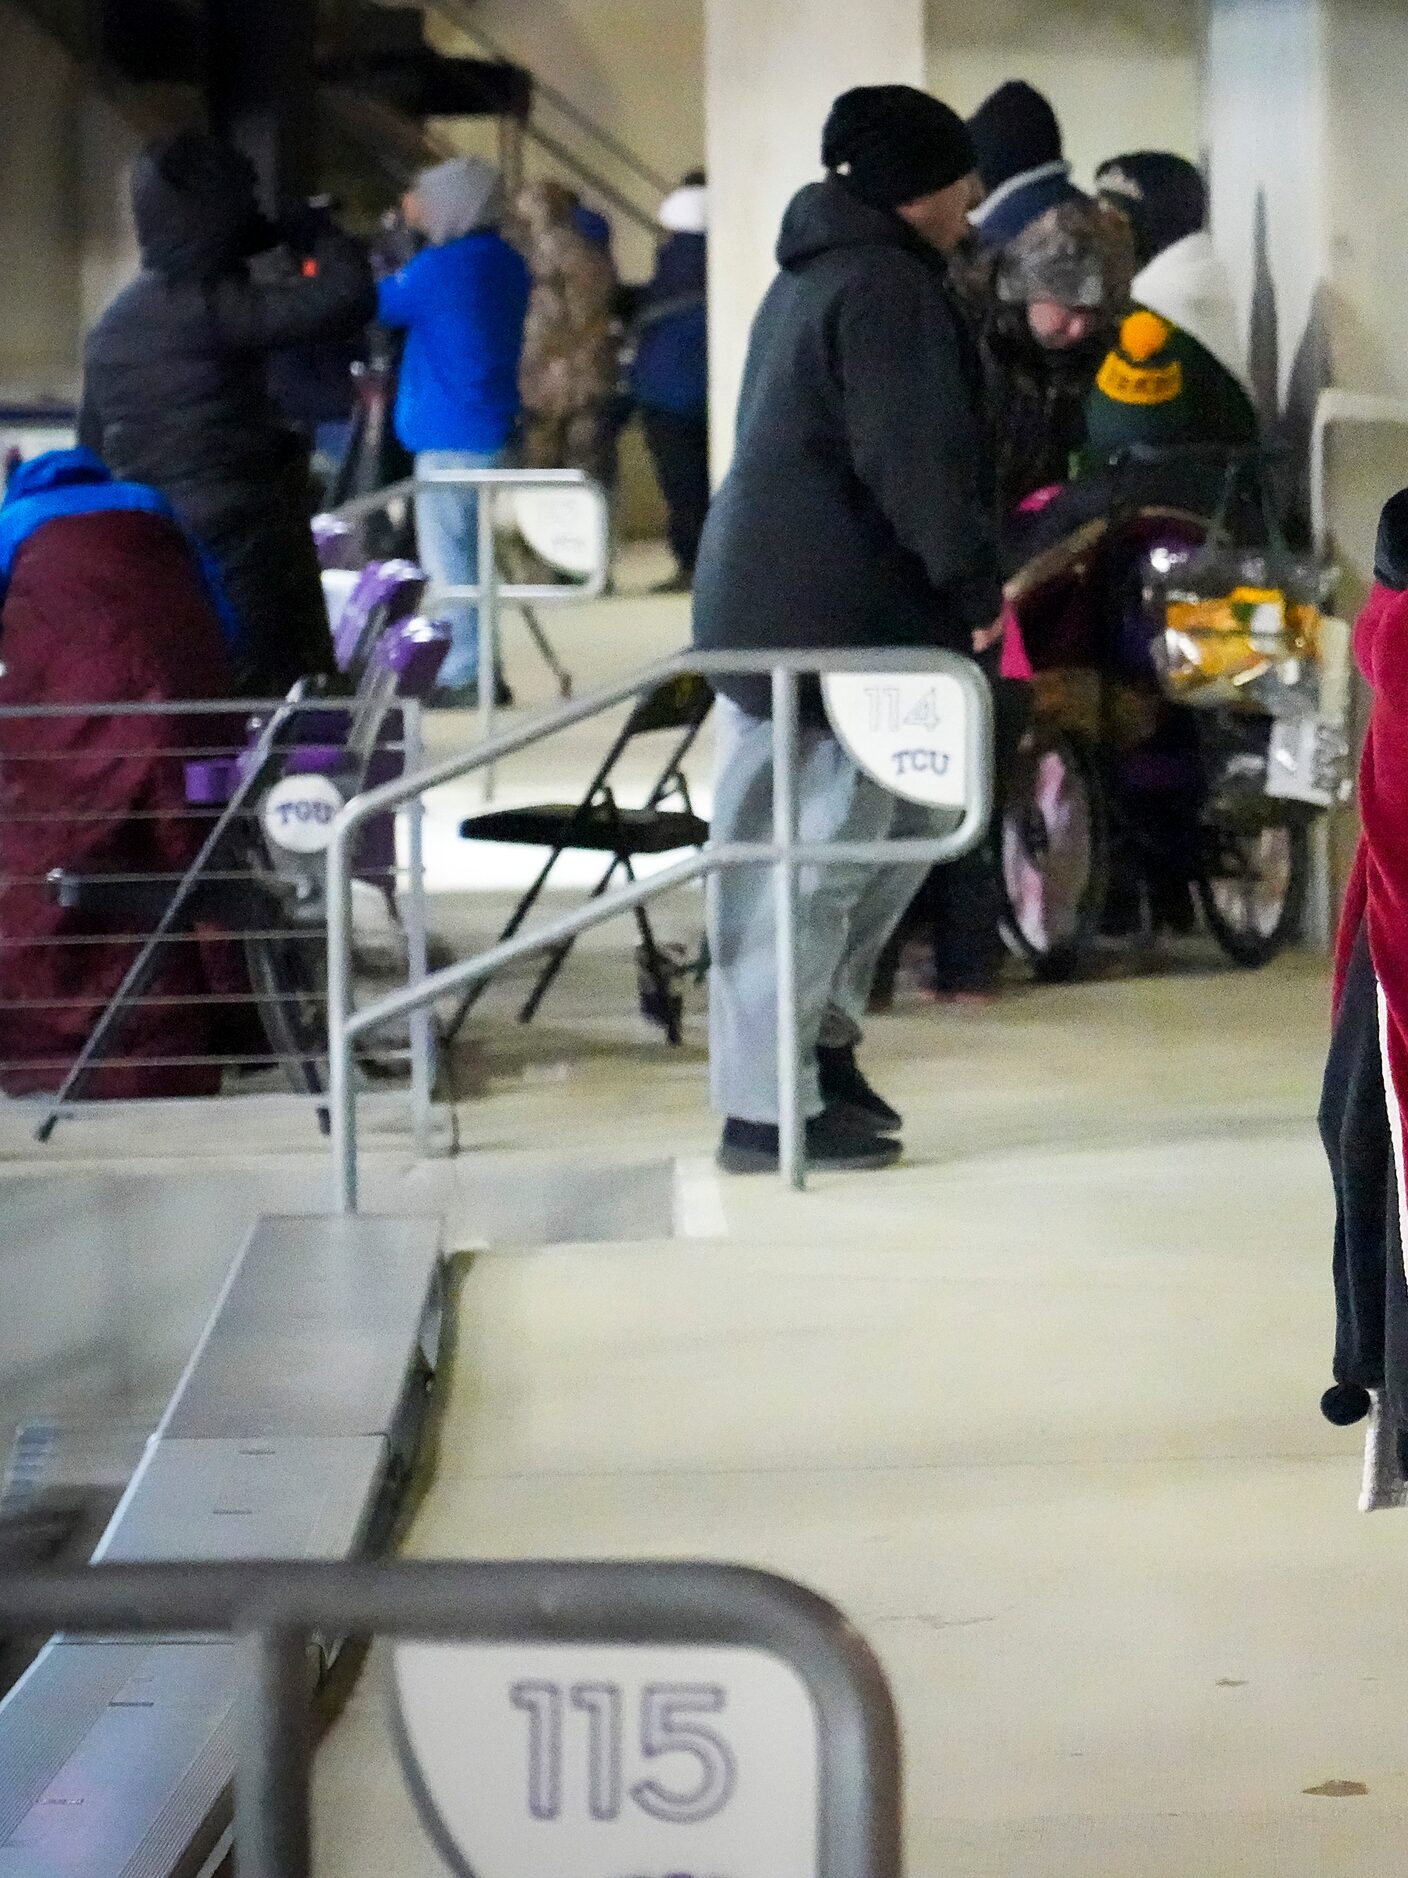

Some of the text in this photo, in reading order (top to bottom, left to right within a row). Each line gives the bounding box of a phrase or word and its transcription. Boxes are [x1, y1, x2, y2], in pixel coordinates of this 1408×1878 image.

[863, 686, 941, 732] 114
[891, 748, 950, 776] TCU
[508, 1680, 739, 1825] 115
